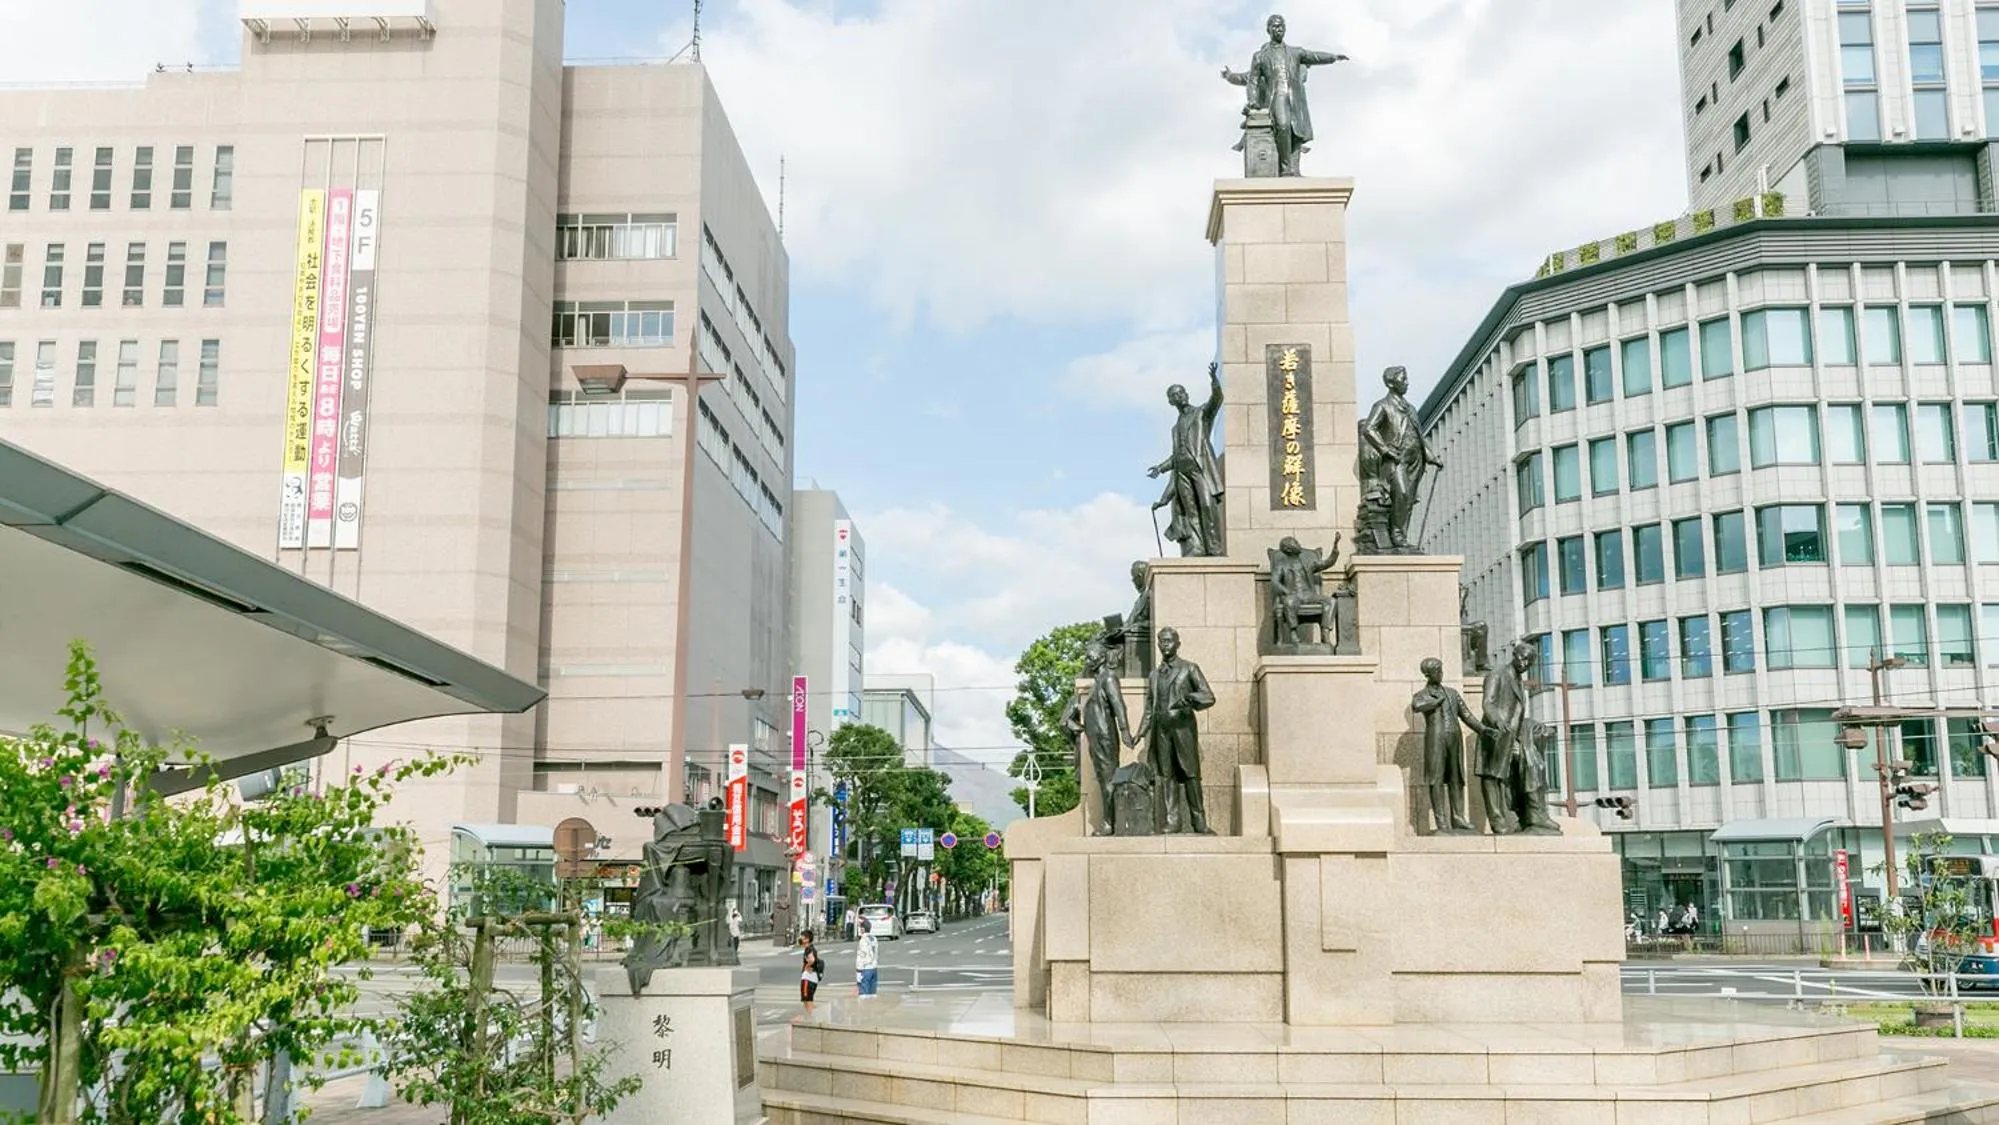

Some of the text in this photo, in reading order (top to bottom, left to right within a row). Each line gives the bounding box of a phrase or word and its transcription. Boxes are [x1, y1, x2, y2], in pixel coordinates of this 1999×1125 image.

[350, 287, 368, 390] 100YEN SHOP
[1279, 348, 1306, 506] 若き薩摩の群像
[652, 1014, 674, 1070] 黎明
